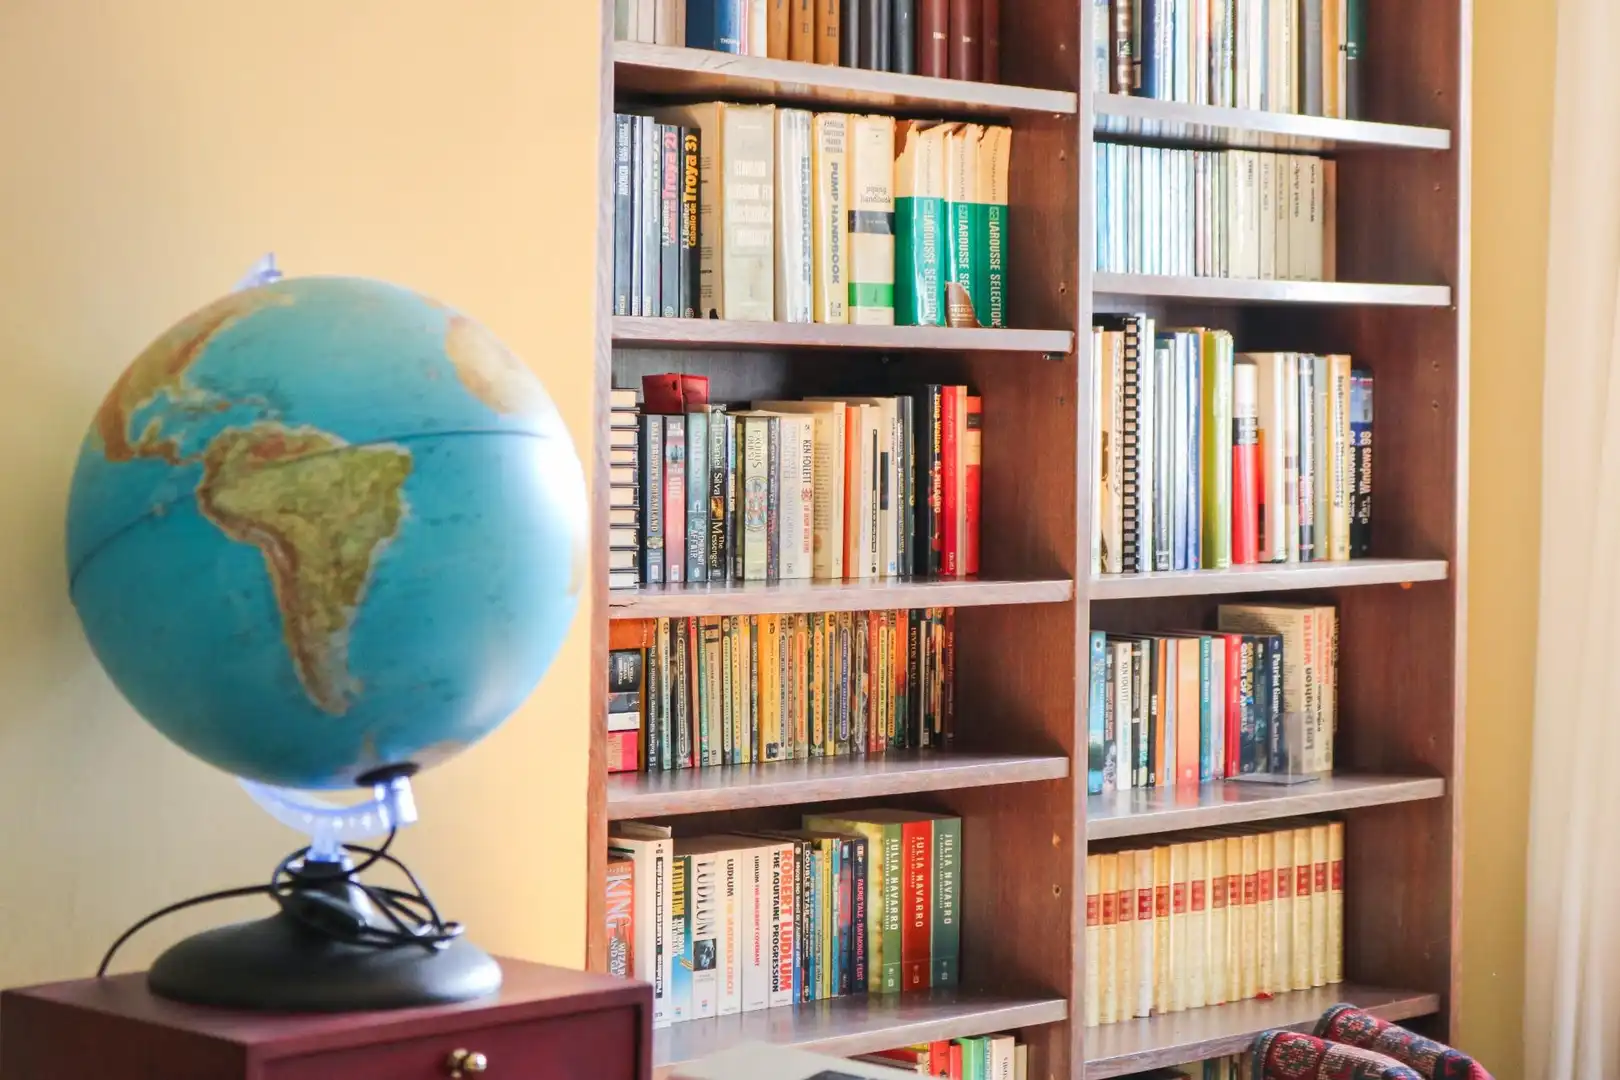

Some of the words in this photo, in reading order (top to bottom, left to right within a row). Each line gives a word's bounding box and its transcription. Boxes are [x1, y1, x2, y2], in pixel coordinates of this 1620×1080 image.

[662, 152, 677, 200] Troya
[684, 155, 699, 203] Troya
[831, 162, 839, 202] PUMP
[832, 204, 840, 285] HANDBOOK
[923, 213, 935, 264] LAROUSSE
[958, 220, 969, 269] LAROUSSE
[989, 221, 1001, 270] LAROUSSE
[990, 273, 1001, 326] SELECTION
[714, 436, 725, 468] Daniel
[803, 440, 811, 454] KEN
[1360, 431, 1372, 446] 98
[713, 472, 724, 495] Silva
[803, 456, 812, 484] FOLLETT
[1360, 447, 1372, 495] Windows
[690, 529, 698, 558] AFFAIR
[709, 521, 723, 567] Messenger
[1272, 653, 1281, 687] Patriot
[1304, 667, 1314, 725] Deighton
[1304, 727, 1314, 750] Len
[772, 851, 780, 869] THE
[890, 839, 899, 872] JULIA
[916, 837, 924, 869] JULIA
[944, 834, 952, 866] JULIA
[607, 873, 632, 929] KING
[696, 860, 716, 937] LUDLUM
[726, 858, 734, 897] LUDLUM
[772, 871, 780, 921] AQUITAINE
[780, 849, 793, 916] ROBERT
[915, 874, 924, 928] NAVARRO
[944, 872, 952, 925] NAVARRO
[890, 877, 899, 930] NAVARRO
[609, 936, 618, 957] AND
[618, 942, 627, 975] WIZAR
[772, 924, 780, 992] PROGRESSION
[779, 921, 793, 991] LUDLUM
[856, 923, 864, 955] RAYMOND
